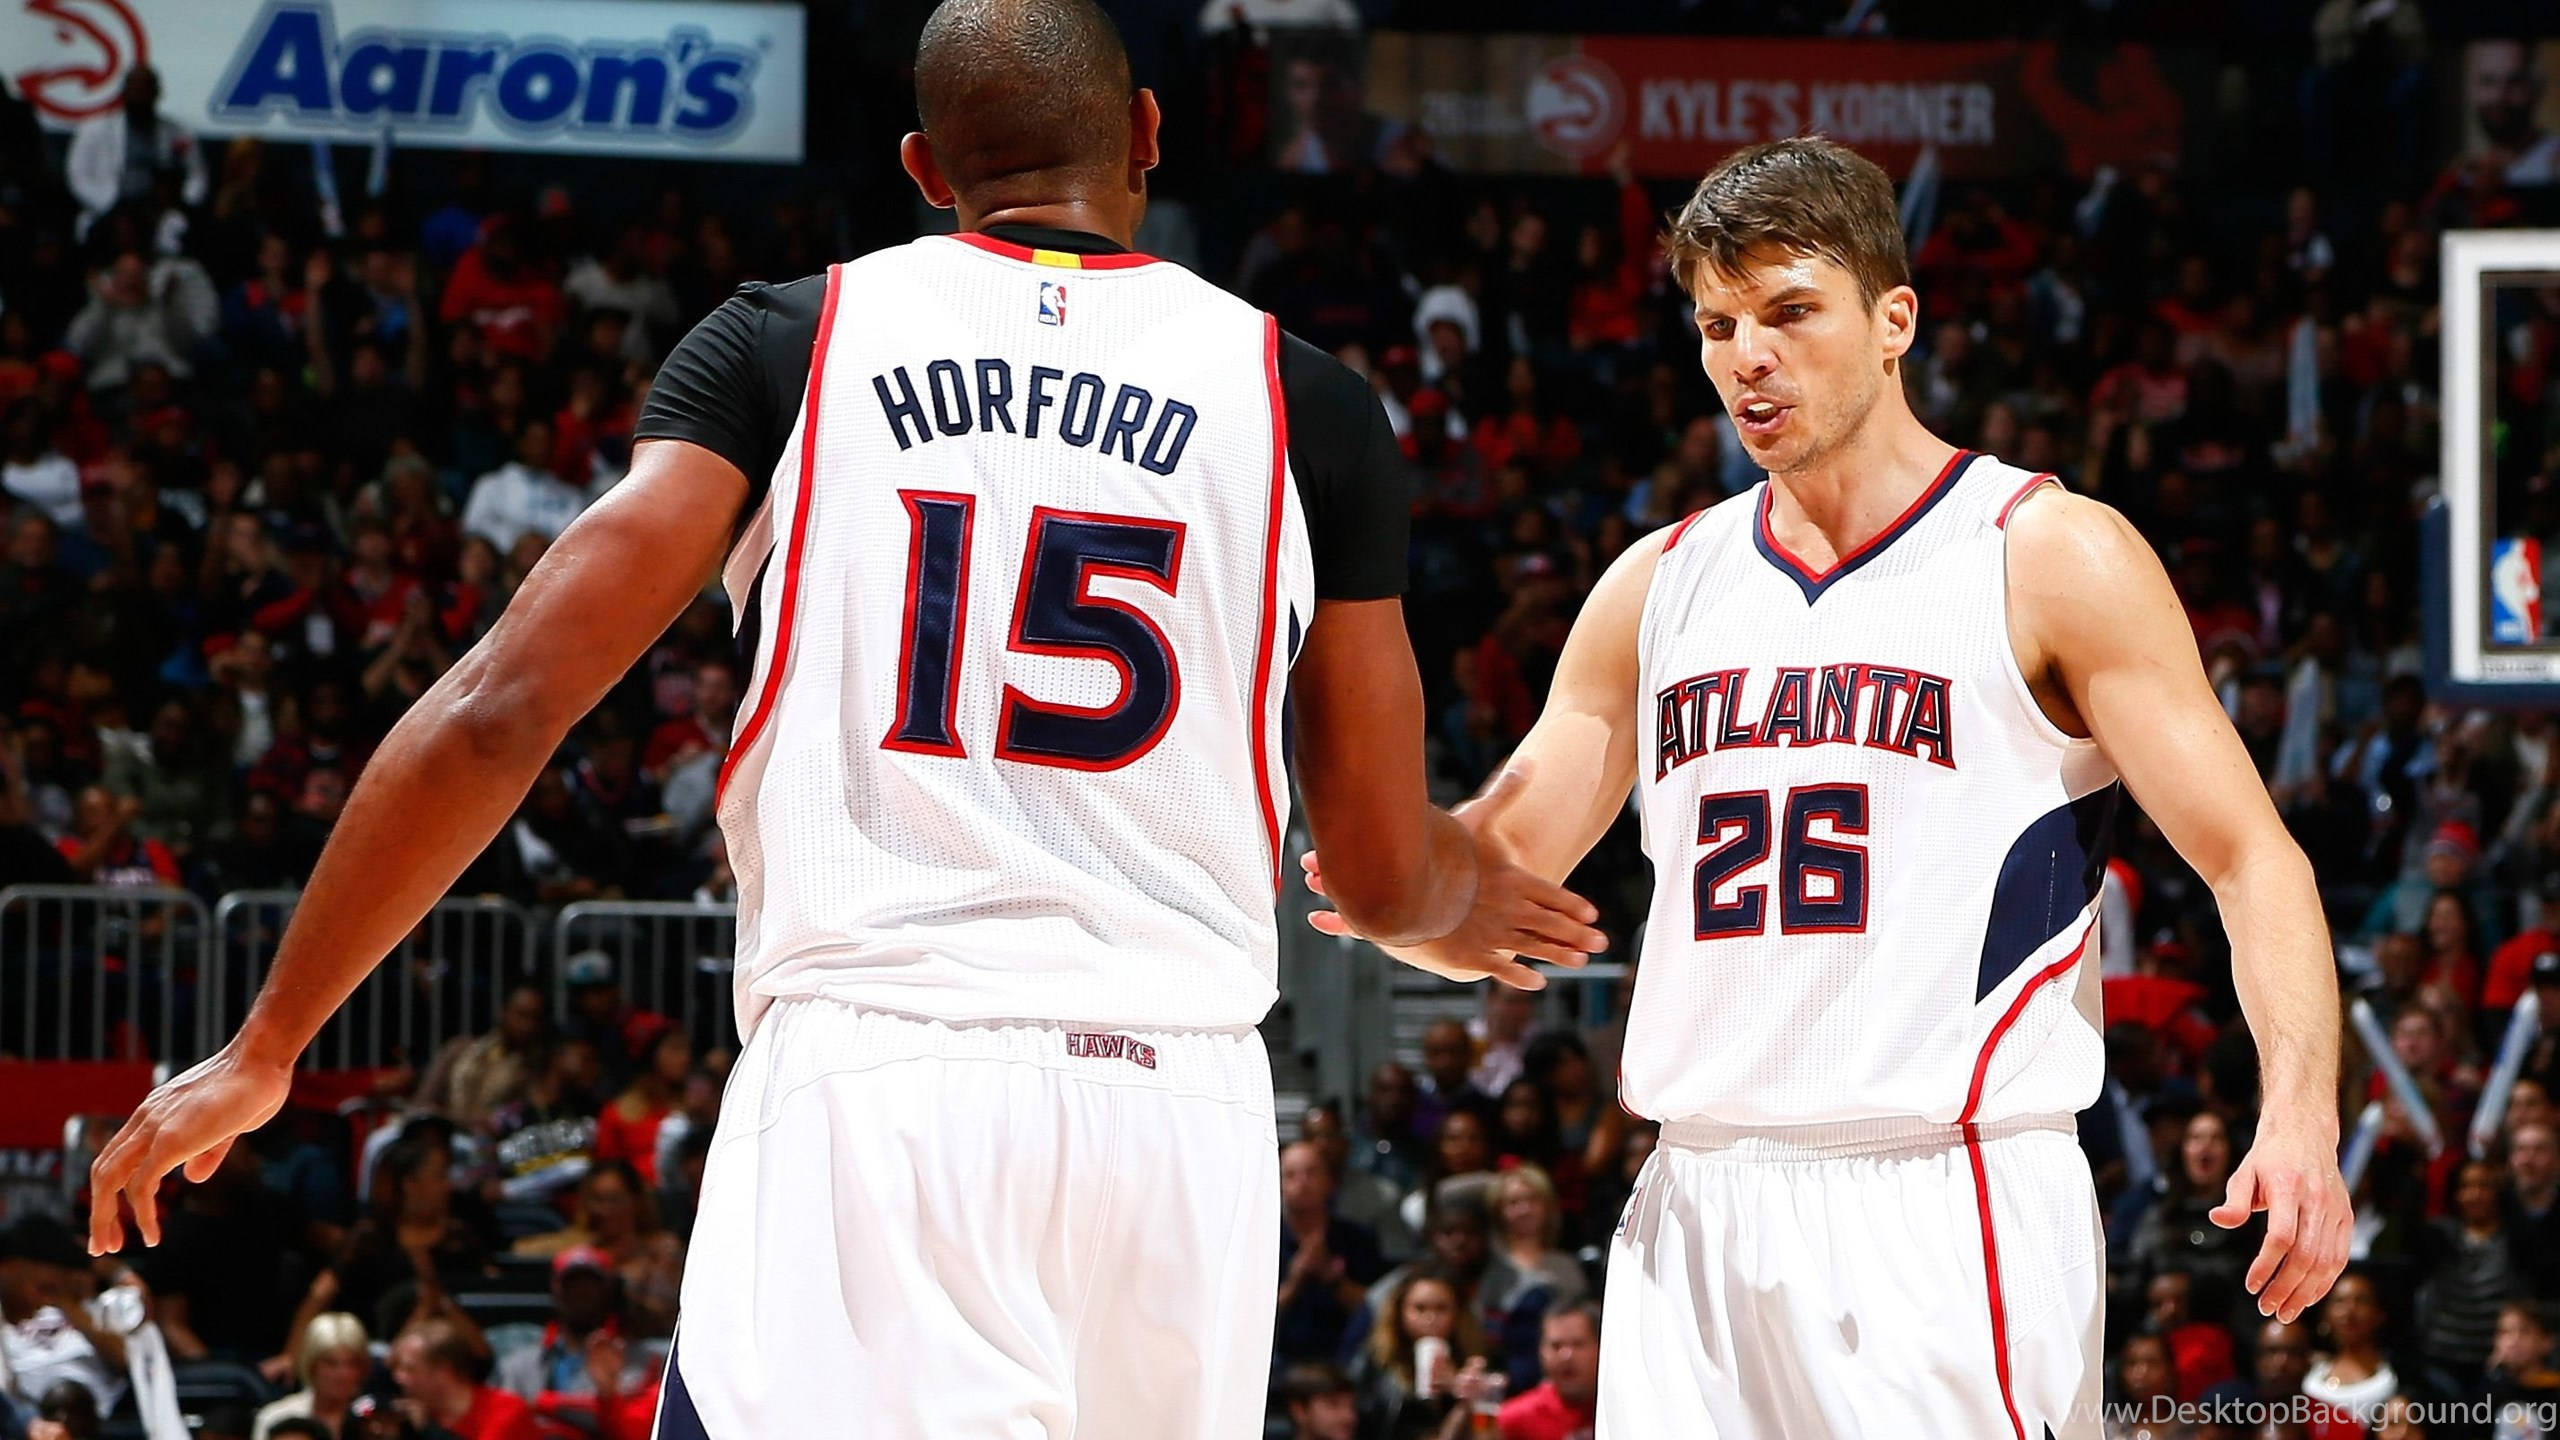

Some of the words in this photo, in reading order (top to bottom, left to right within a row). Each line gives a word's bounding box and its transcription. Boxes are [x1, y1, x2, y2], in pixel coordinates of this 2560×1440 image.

[220, 6, 750, 136] Aaron's
[1640, 76, 1799, 142] KYLE'S
[1809, 78, 1996, 147] KORNER
[872, 358, 1198, 476] HORFORD
[880, 489, 1187, 772] 15
[1655, 663, 1957, 783] ATLANTA
[1693, 782, 1869, 941] 26
[1066, 1033, 1156, 1070] HAWKS
